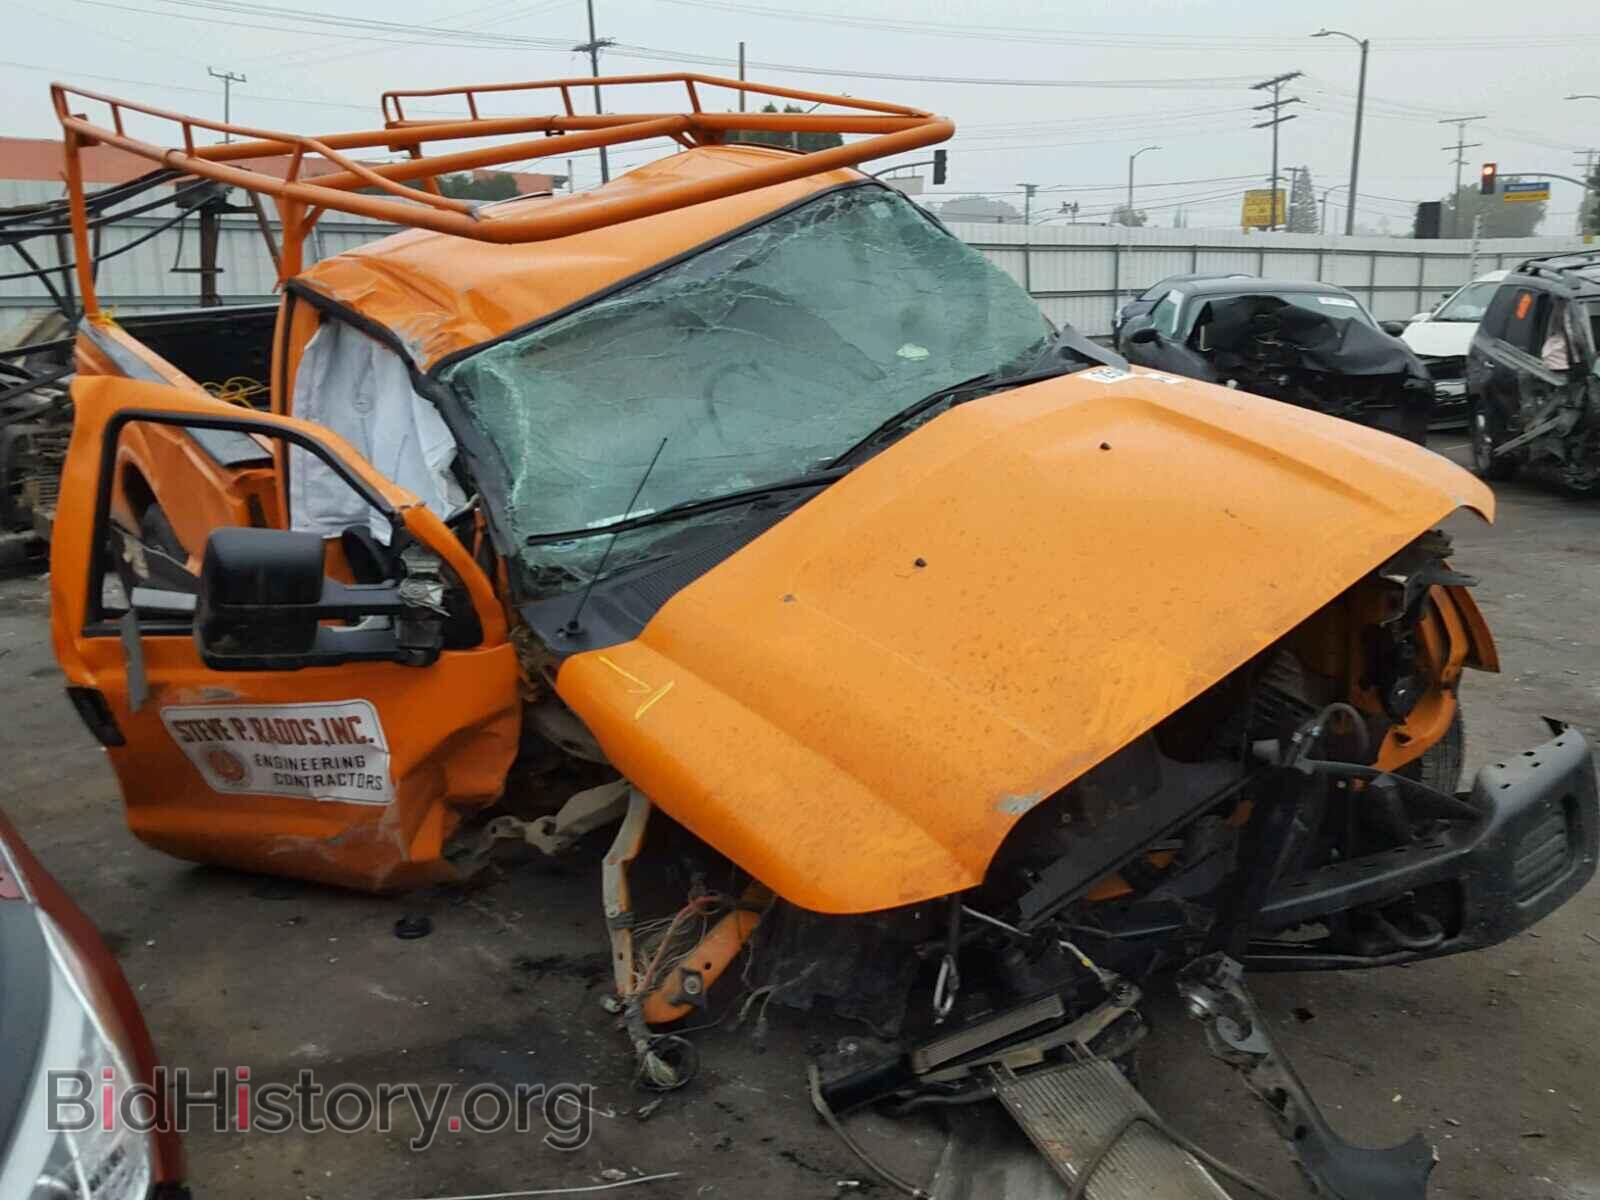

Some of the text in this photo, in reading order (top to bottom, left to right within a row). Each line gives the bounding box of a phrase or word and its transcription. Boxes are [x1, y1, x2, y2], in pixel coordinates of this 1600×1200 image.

[171, 717, 234, 742] STEVE
[253, 753, 367, 772] ENGINEERING
[272, 772, 383, 791] CONTRACTORS
